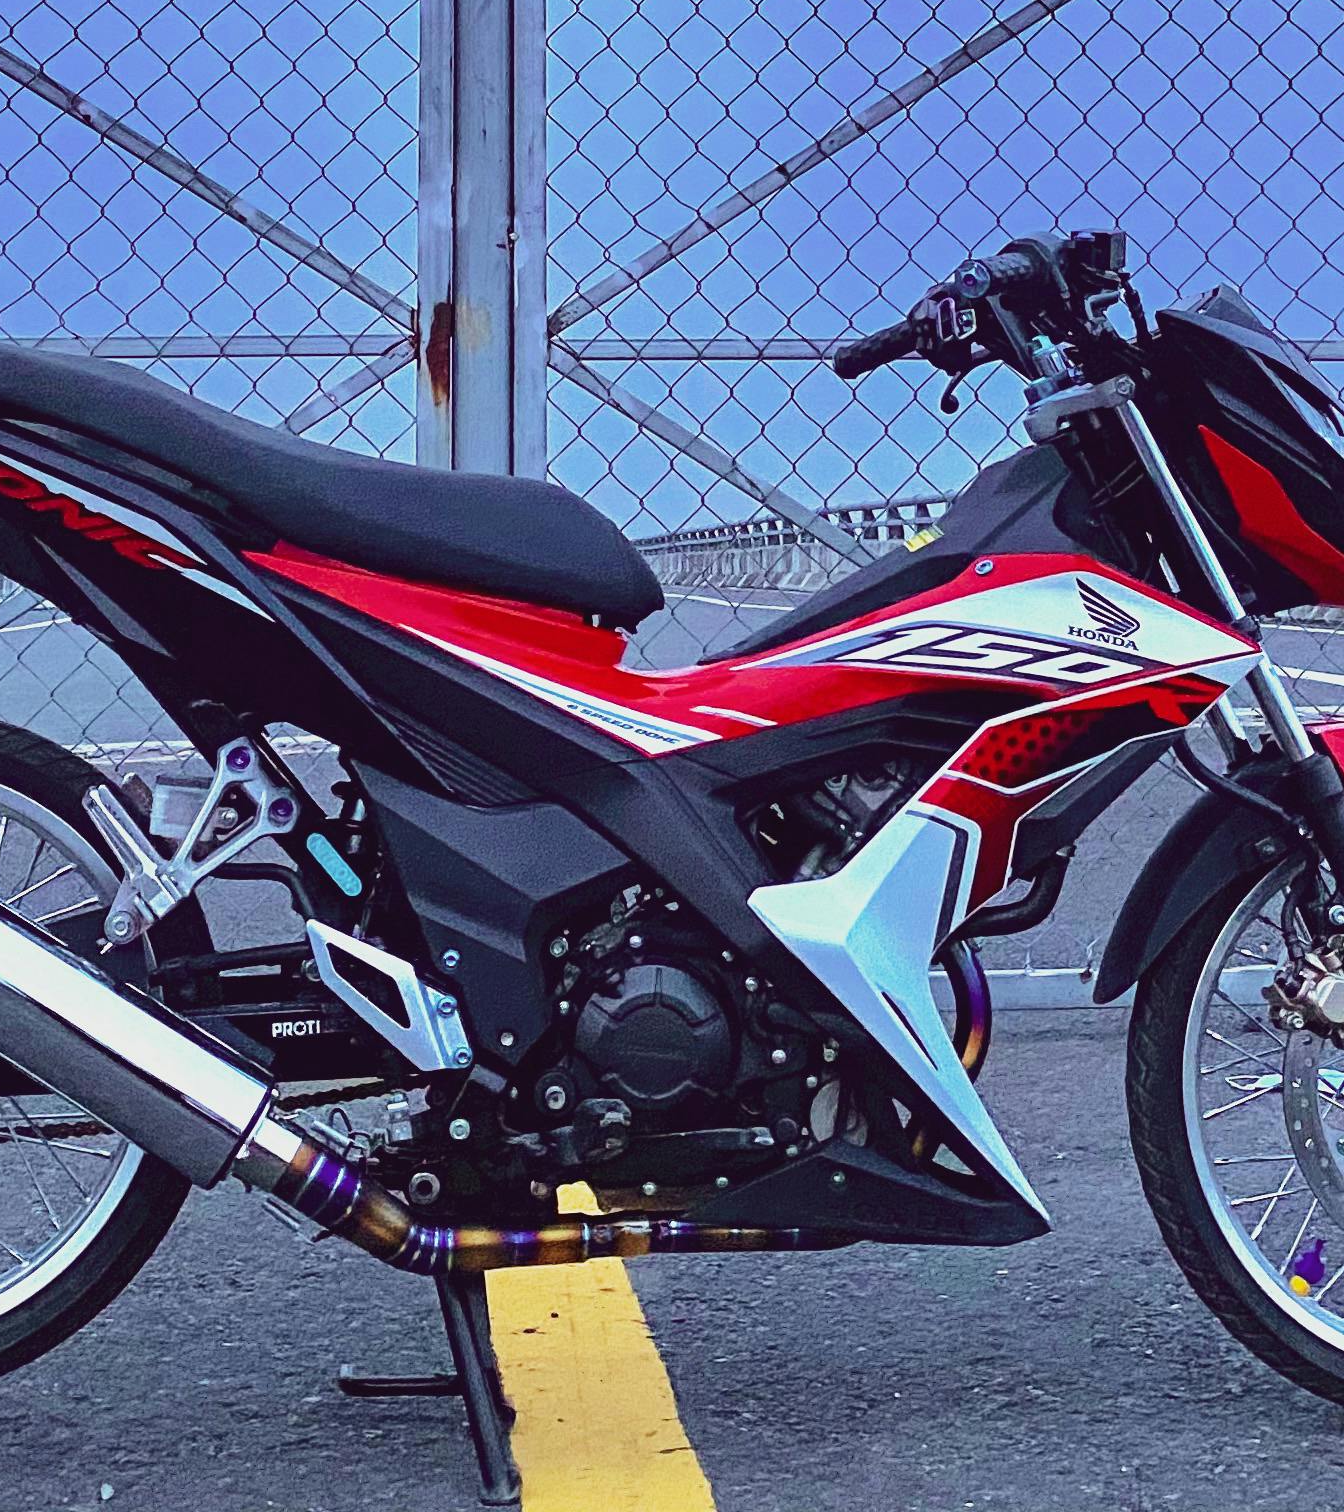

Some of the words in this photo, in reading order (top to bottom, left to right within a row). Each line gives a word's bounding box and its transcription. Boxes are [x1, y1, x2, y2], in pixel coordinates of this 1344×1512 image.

[1067, 625, 1139, 652] HONDA
[835, 626, 1144, 684] 150
[271, 1019, 321, 1038] PROTI
